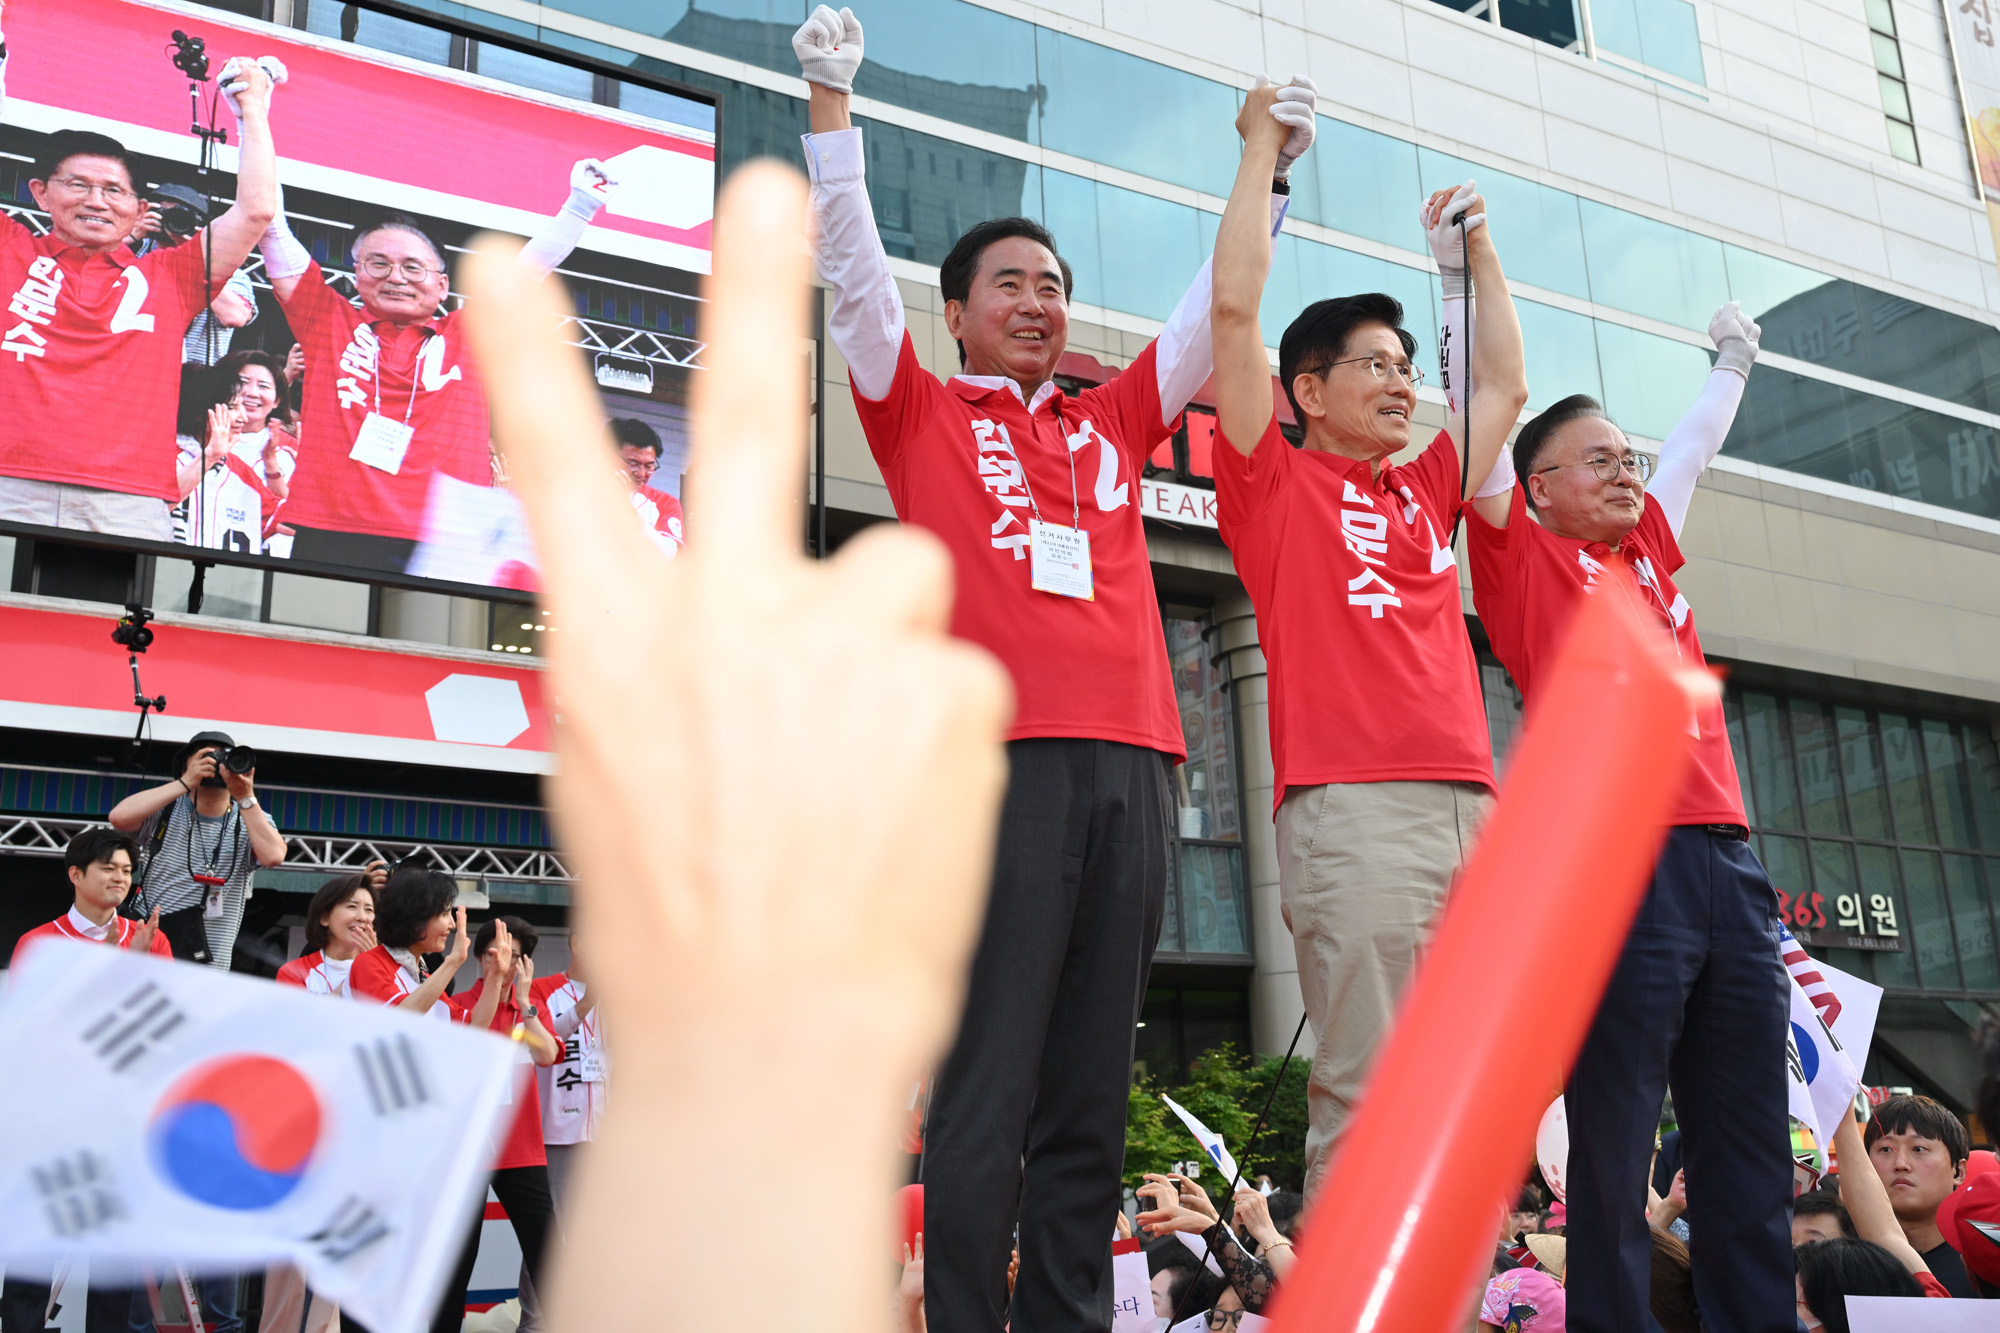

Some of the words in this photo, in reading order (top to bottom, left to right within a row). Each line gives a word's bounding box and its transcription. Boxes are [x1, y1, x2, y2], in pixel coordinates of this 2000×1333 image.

[110, 264, 156, 334] 2
[971, 418, 1031, 561] 김문수
[1067, 419, 1131, 512] 2
[1039, 530, 1080, 544] 선거사무원
[1775, 887, 1827, 929] 365
[1836, 892, 1900, 937] 의원
